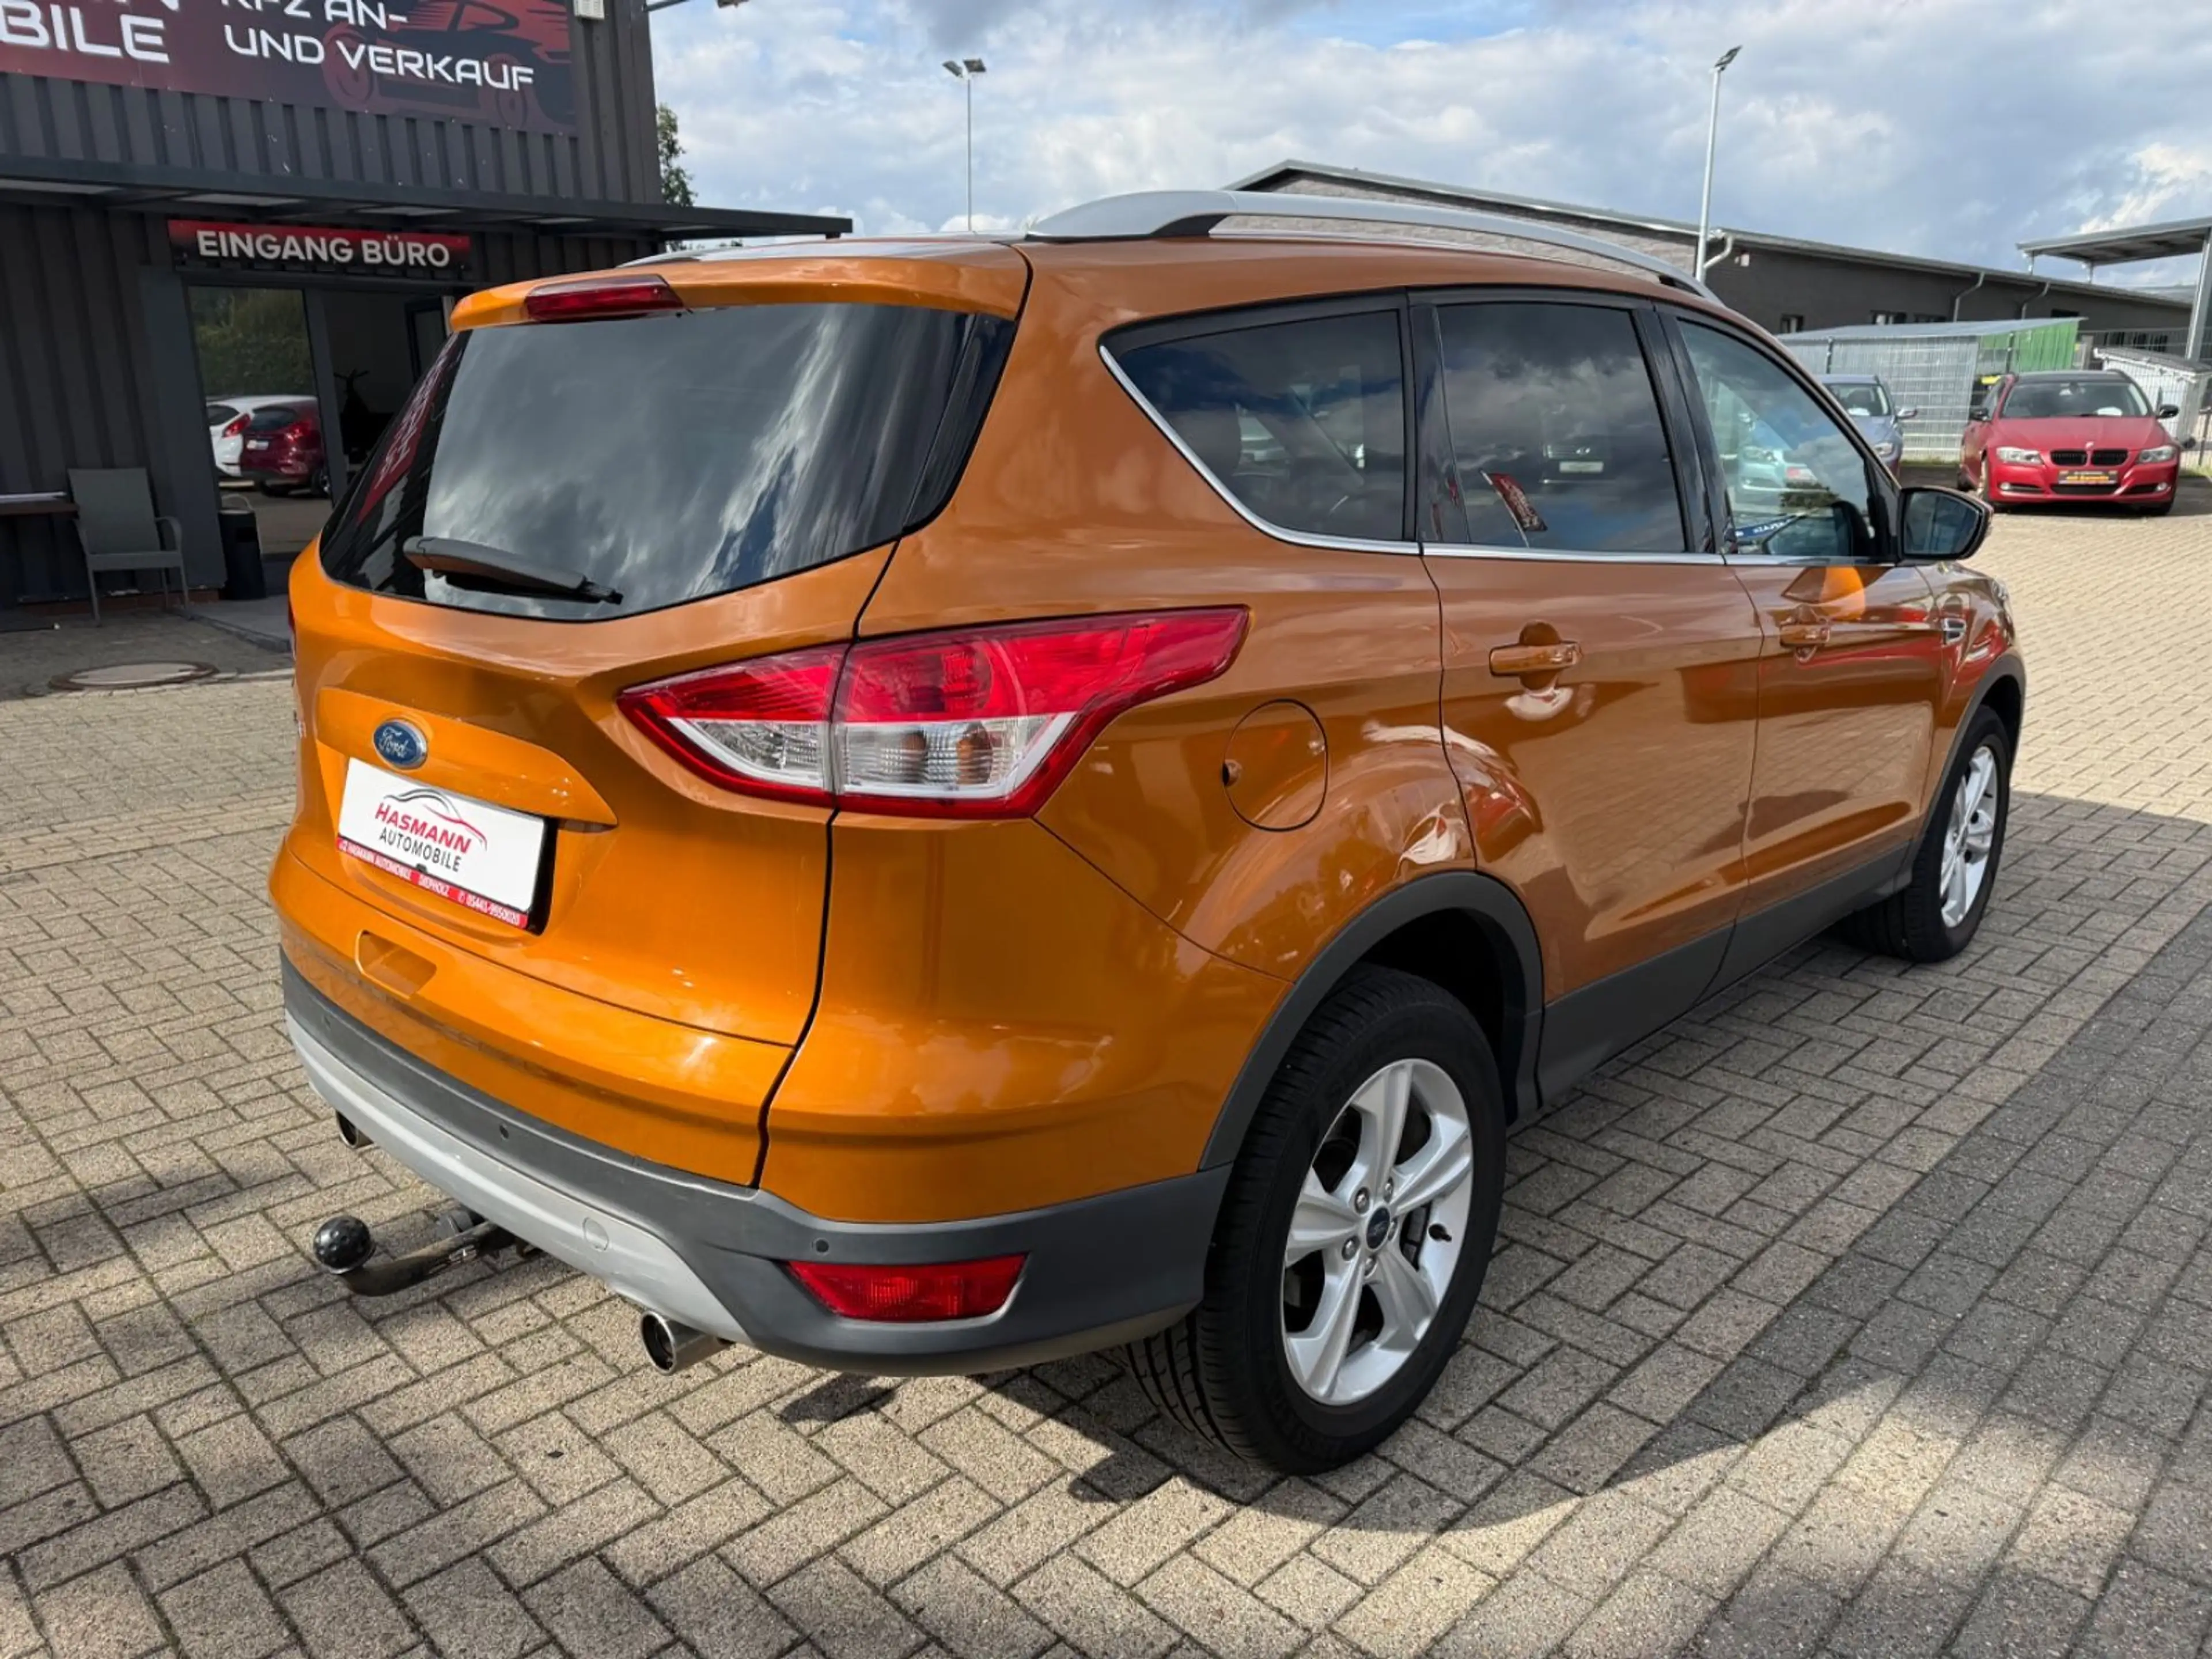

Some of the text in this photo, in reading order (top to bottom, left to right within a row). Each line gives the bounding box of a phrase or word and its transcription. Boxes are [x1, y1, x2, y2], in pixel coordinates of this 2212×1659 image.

[224, 24, 534, 91] UND VERKAUF
[196, 230, 450, 267] EINGANG BÜRO
[375, 802, 472, 854] HASMANN
[380, 827, 462, 872] AUTOMOBILE
